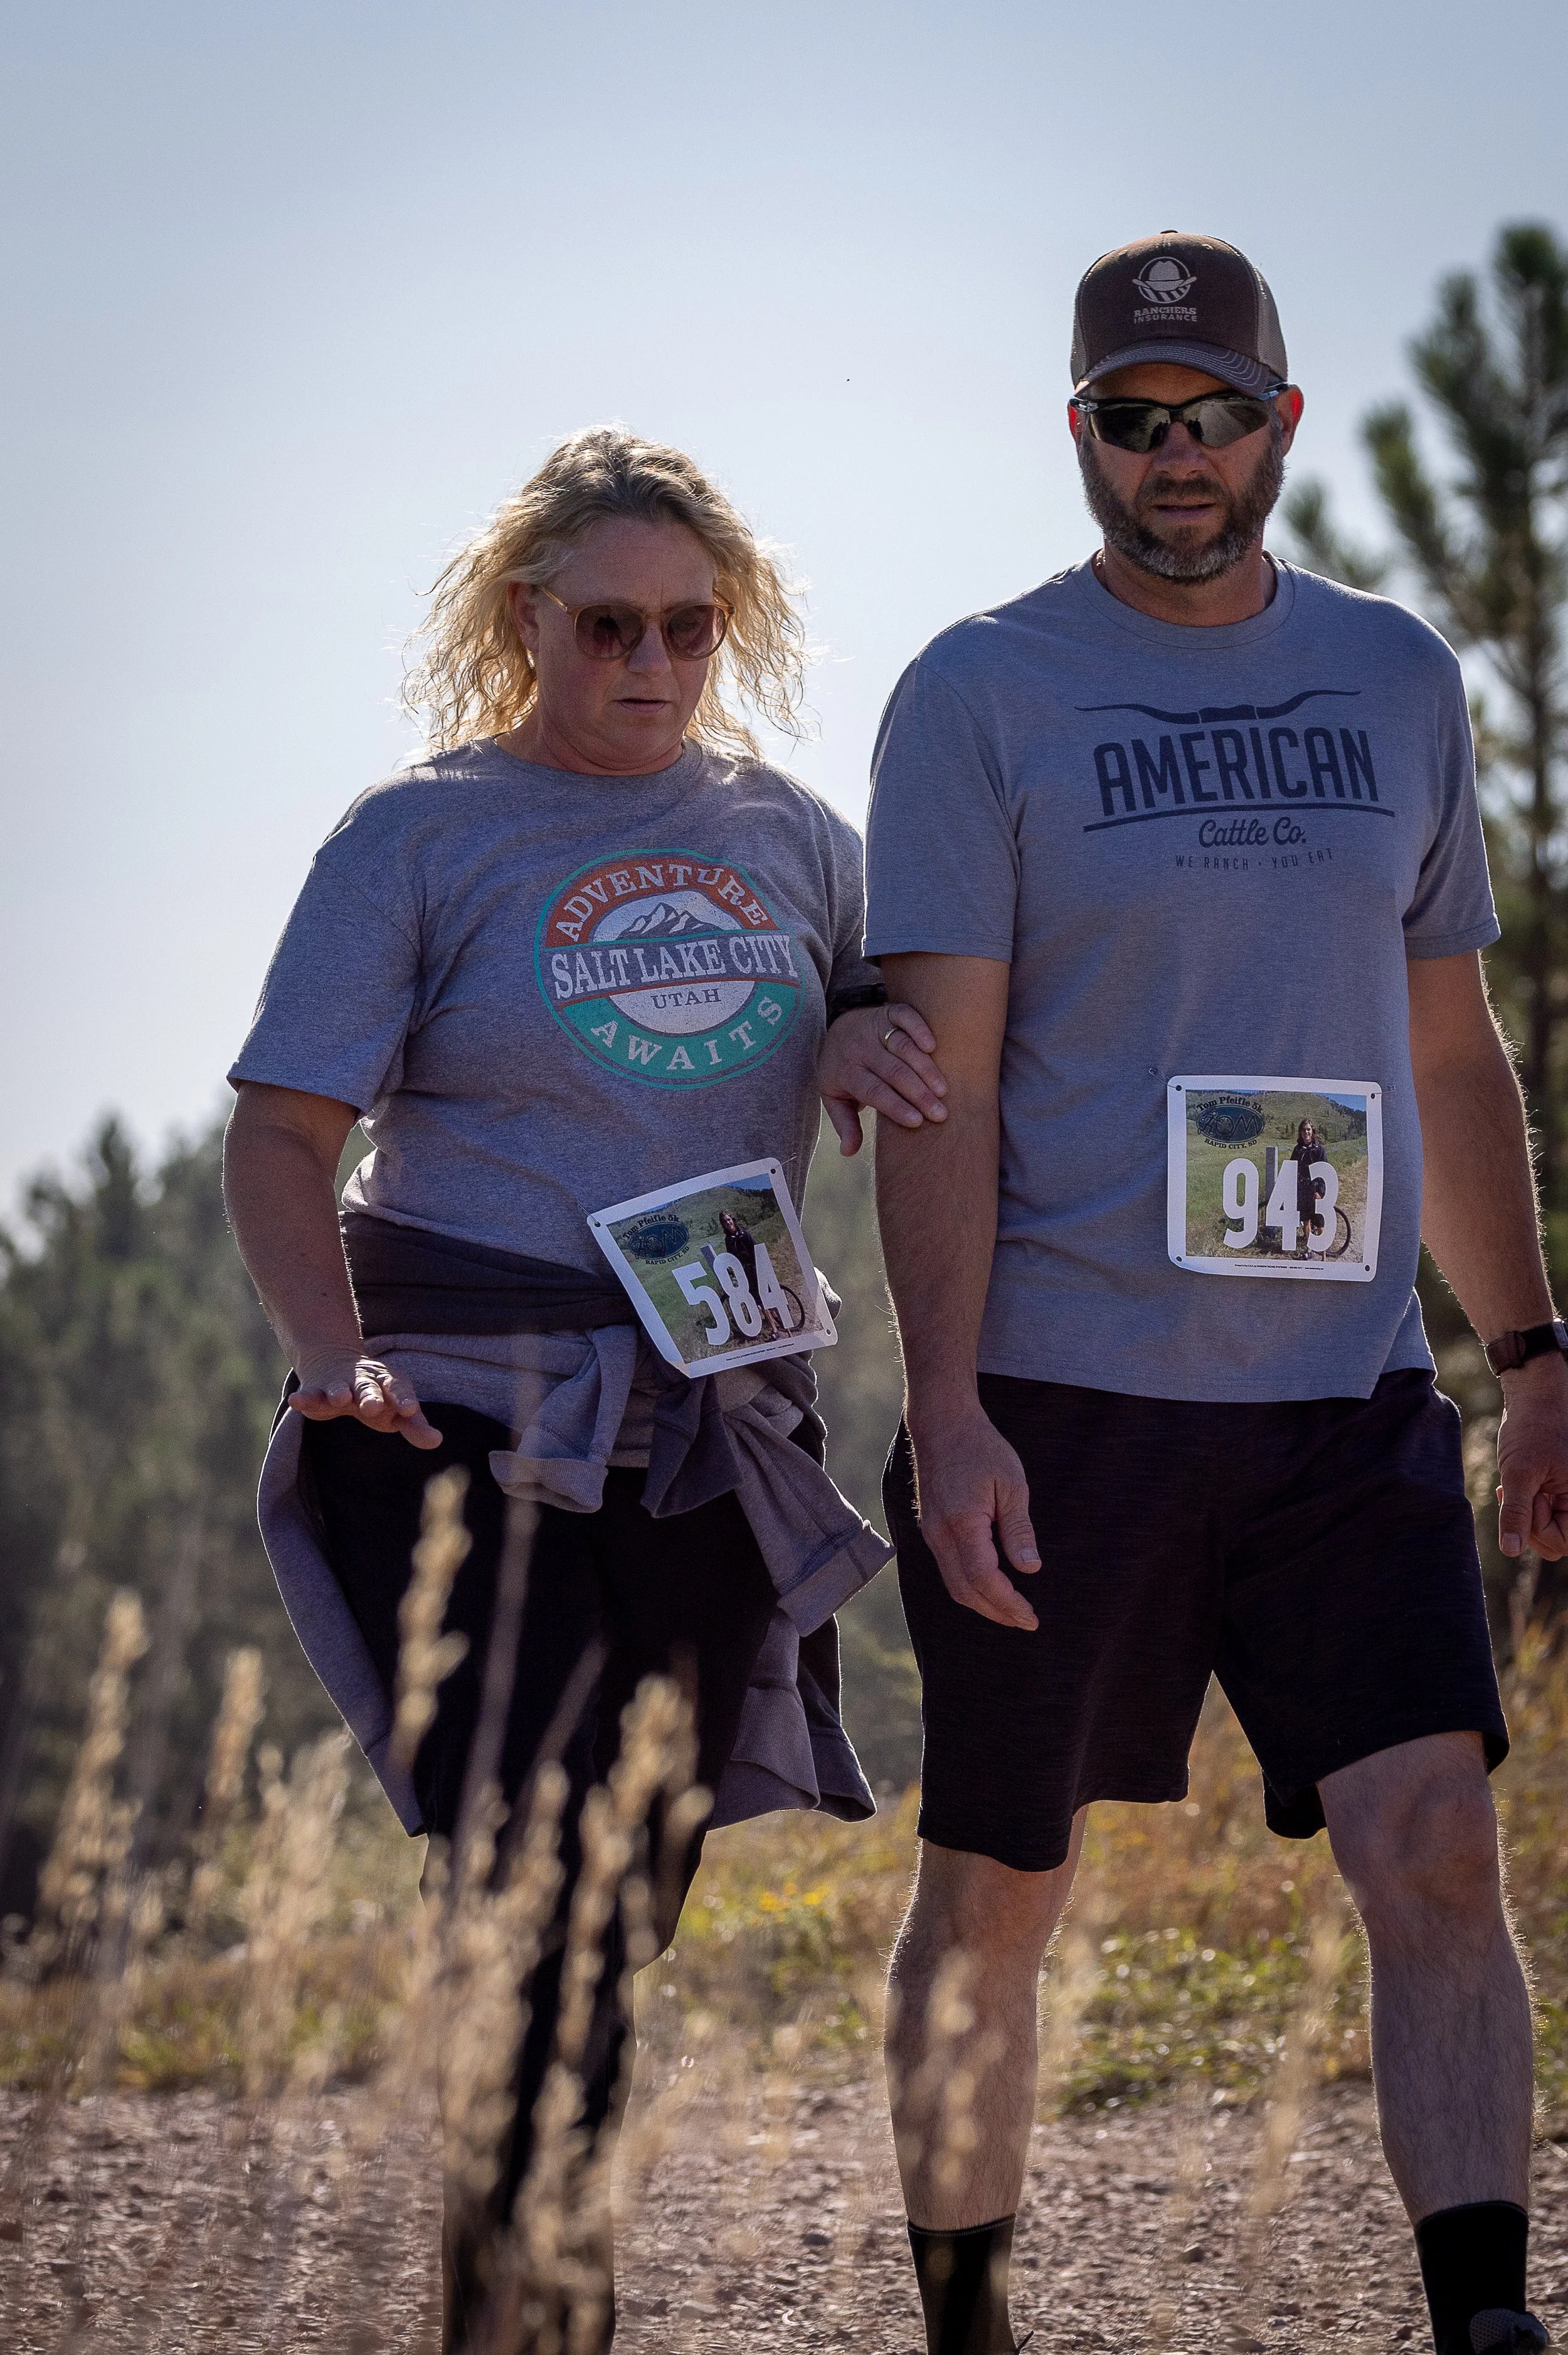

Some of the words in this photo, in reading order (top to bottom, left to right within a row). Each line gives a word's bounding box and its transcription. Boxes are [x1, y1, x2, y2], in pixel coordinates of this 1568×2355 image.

[1133, 307, 1197, 317] RANCHERS
[1133, 314, 1197, 324] INSURANCE
[1093, 727, 1379, 816] AMERICAN
[1199, 819, 1268, 848] Cattle
[1273, 817, 1307, 844] Co.
[1175, 855, 1193, 868] WE
[1204, 856, 1249, 870] RANCH
[1271, 854, 1298, 869] YOU
[1308, 848, 1333, 863] EAT
[556, 864, 768, 942] ADVENTURE
[551, 948, 630, 999] SALT
[633, 939, 726, 983] LAKE
[729, 935, 799, 977] CITY
[652, 988, 721, 1009] UTAH
[591, 996, 782, 1071] AWAITS
[1196, 1099, 1217, 1111] Tom
[1219, 1095, 1251, 1107] Pfeifle
[1251, 1102, 1263, 1114] 5k
[1204, 1138, 1227, 1149] RAPID
[1223, 1158, 1338, 1252] 943
[623, 1226, 638, 1240] Tom
[637, 1215, 666, 1226] Pfeifle
[668, 1214, 680, 1223] 5k
[682, 1246, 690, 1255] SD
[672, 1243, 794, 1346] 584
